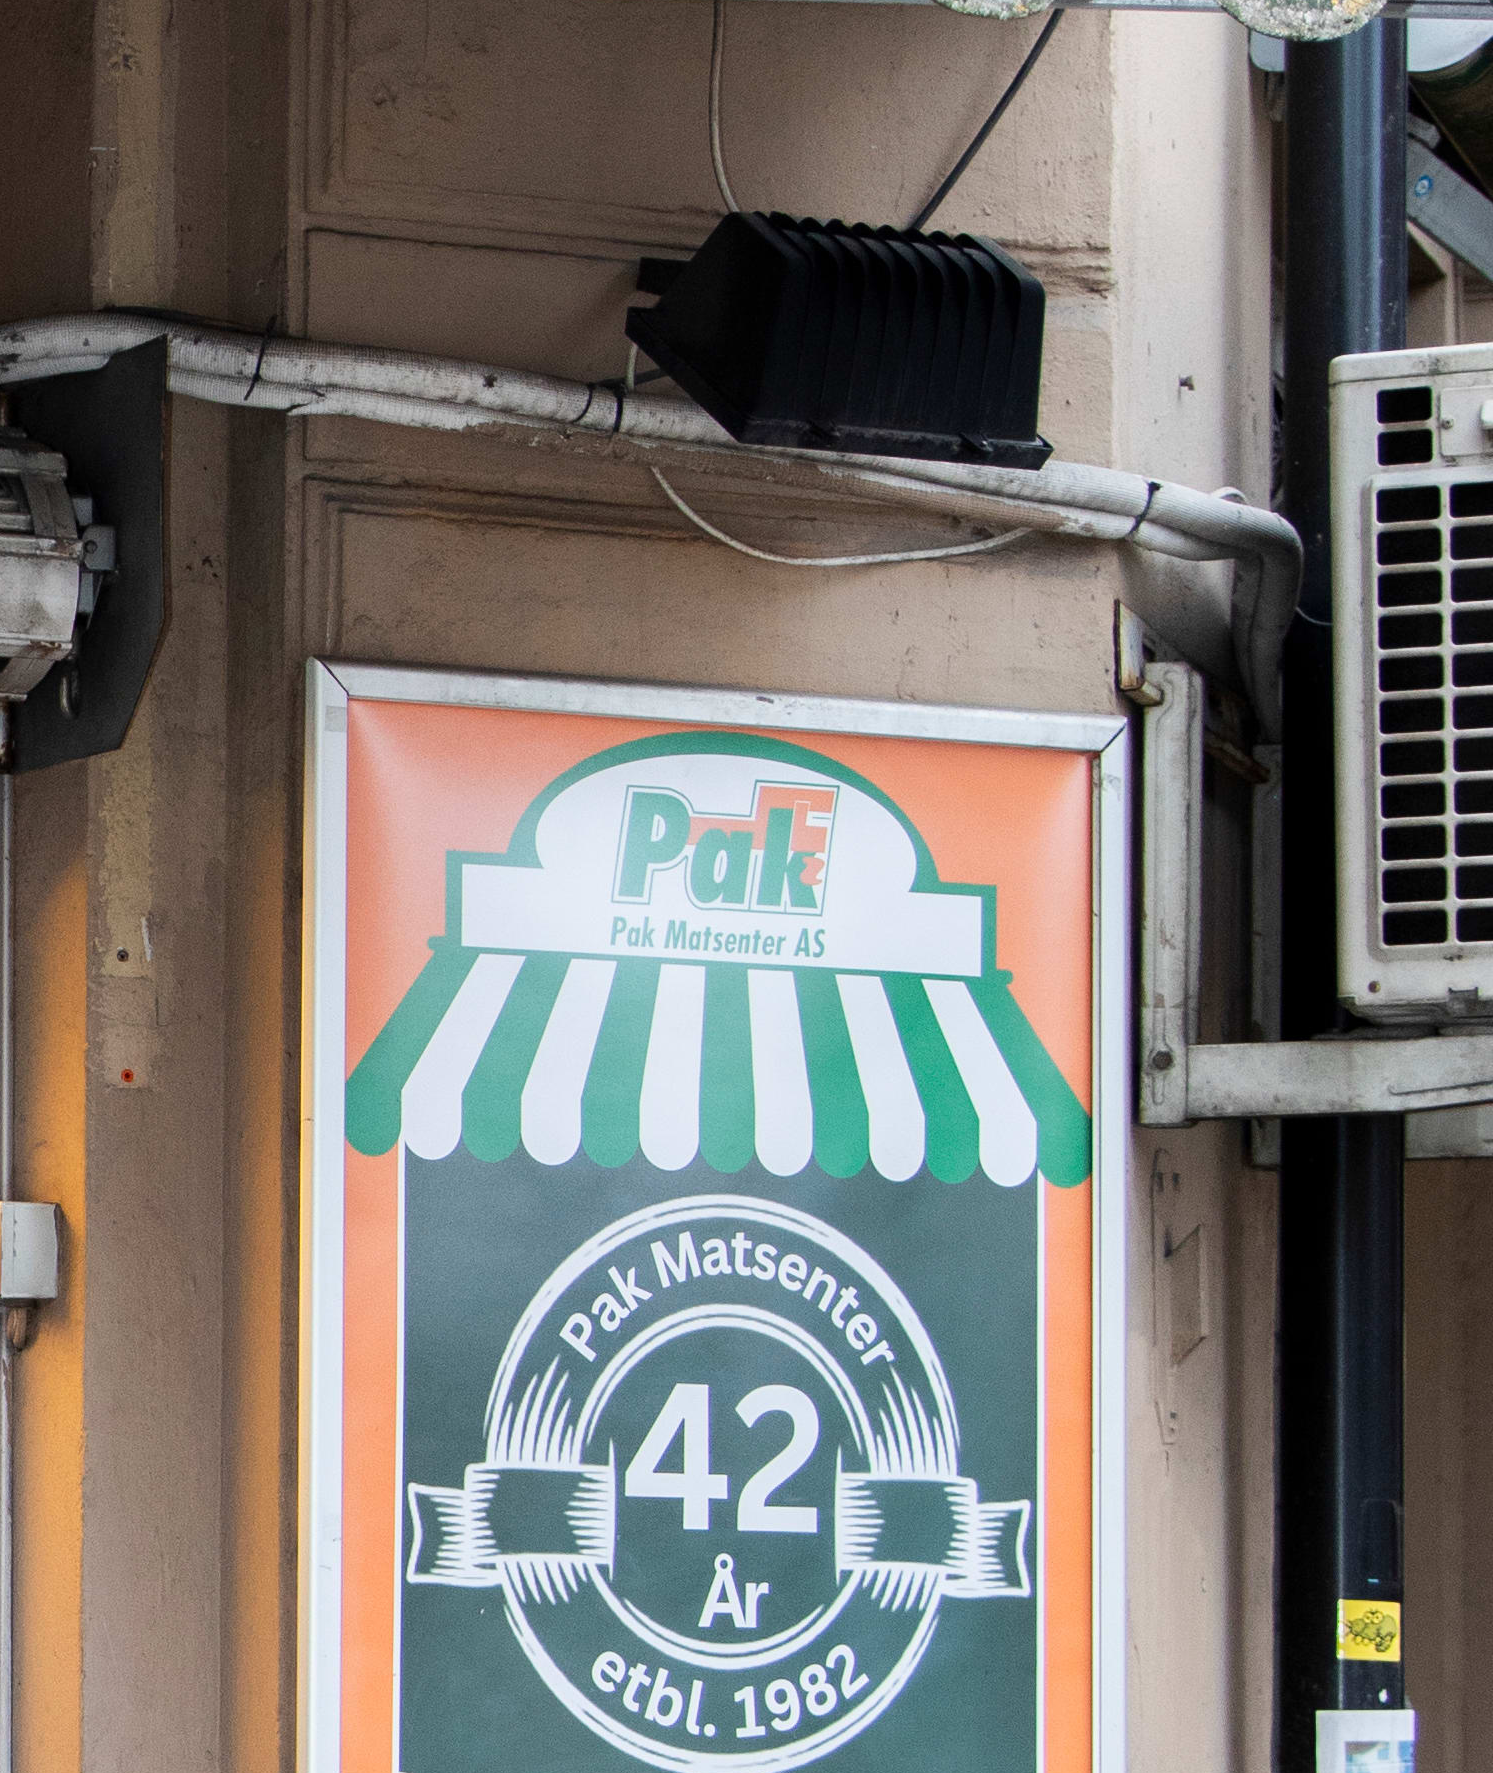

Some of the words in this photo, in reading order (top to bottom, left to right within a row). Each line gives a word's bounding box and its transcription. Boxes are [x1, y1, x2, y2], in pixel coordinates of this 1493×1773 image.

[615, 785, 837, 913] Pak
[611, 917, 655, 948] Pak
[664, 921, 788, 957] Matsenter
[794, 929, 825, 958] AS
[560, 1265, 642, 1363] Pak
[650, 1232, 897, 1371] Matsenter
[624, 1383, 819, 1534] 42
[698, 1553, 769, 1628] År
[591, 1649, 716, 1738] etbl.
[735, 1644, 869, 1738] 1982
